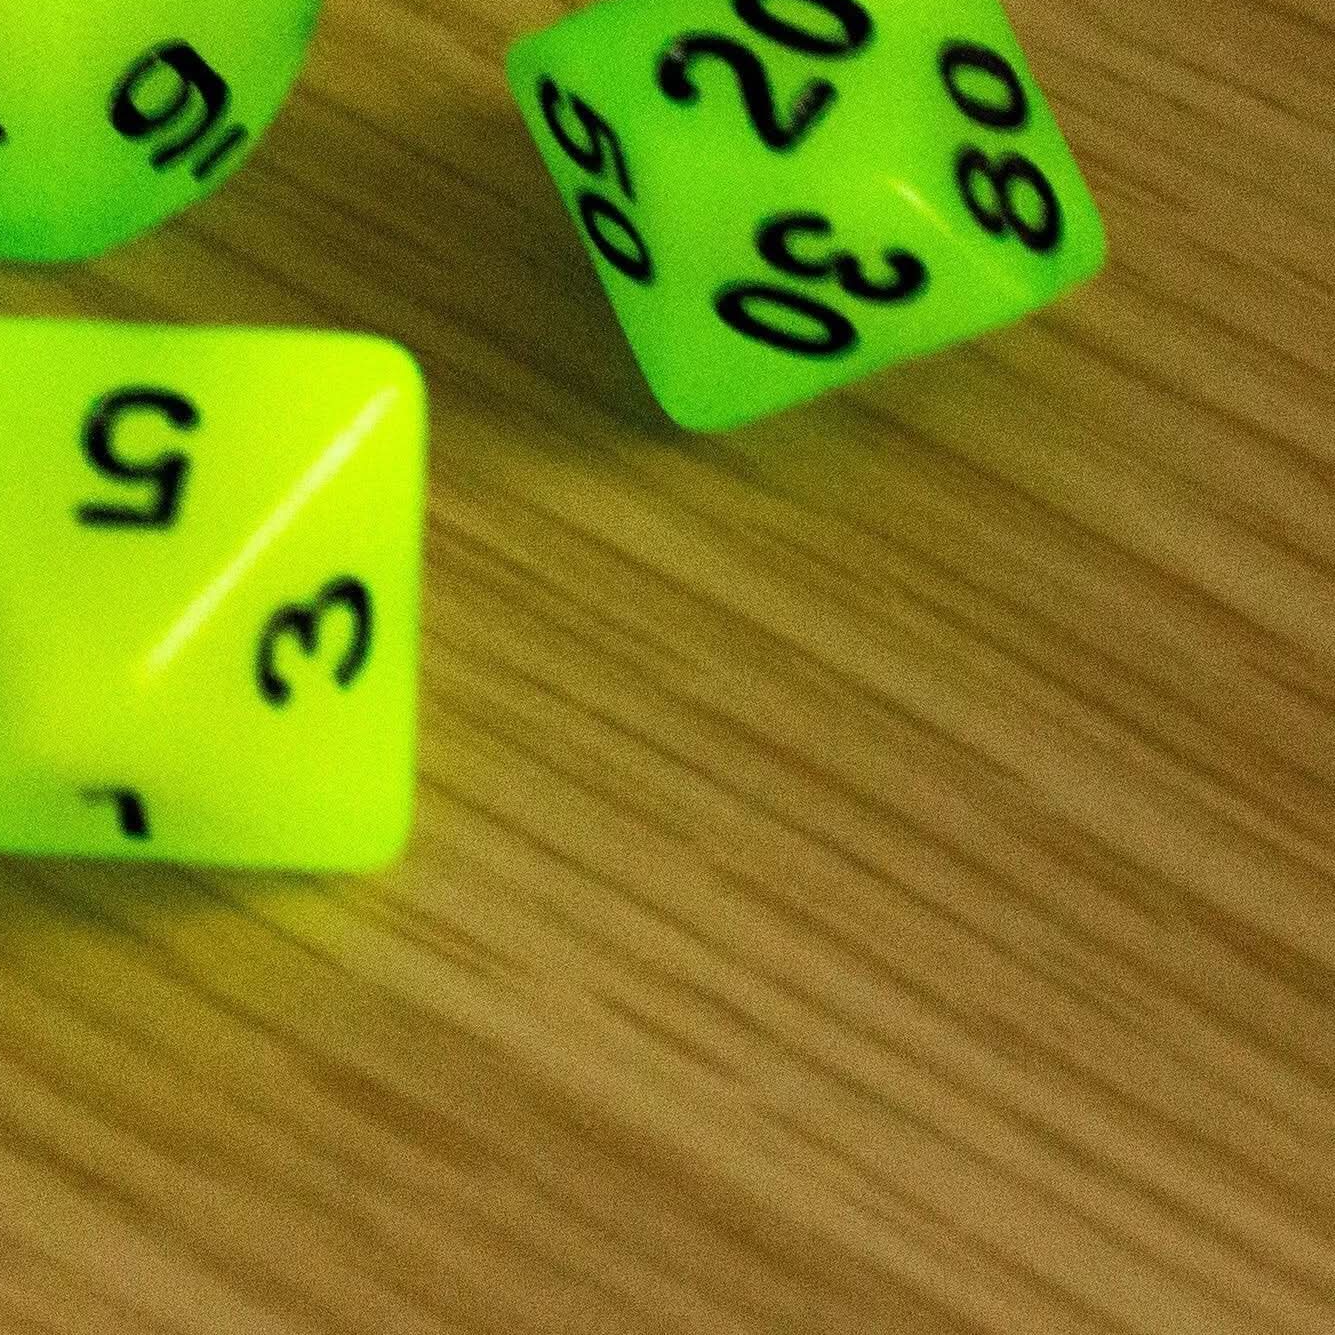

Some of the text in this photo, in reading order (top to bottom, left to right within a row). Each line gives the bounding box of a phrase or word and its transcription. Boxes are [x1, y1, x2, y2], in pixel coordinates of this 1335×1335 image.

[536, 72, 656, 288] 50
[935, 34, 1064, 258] 80
[711, 210, 931, 360] 30
[76, 385, 200, 531] 5
[254, 574, 375, 707] 3
